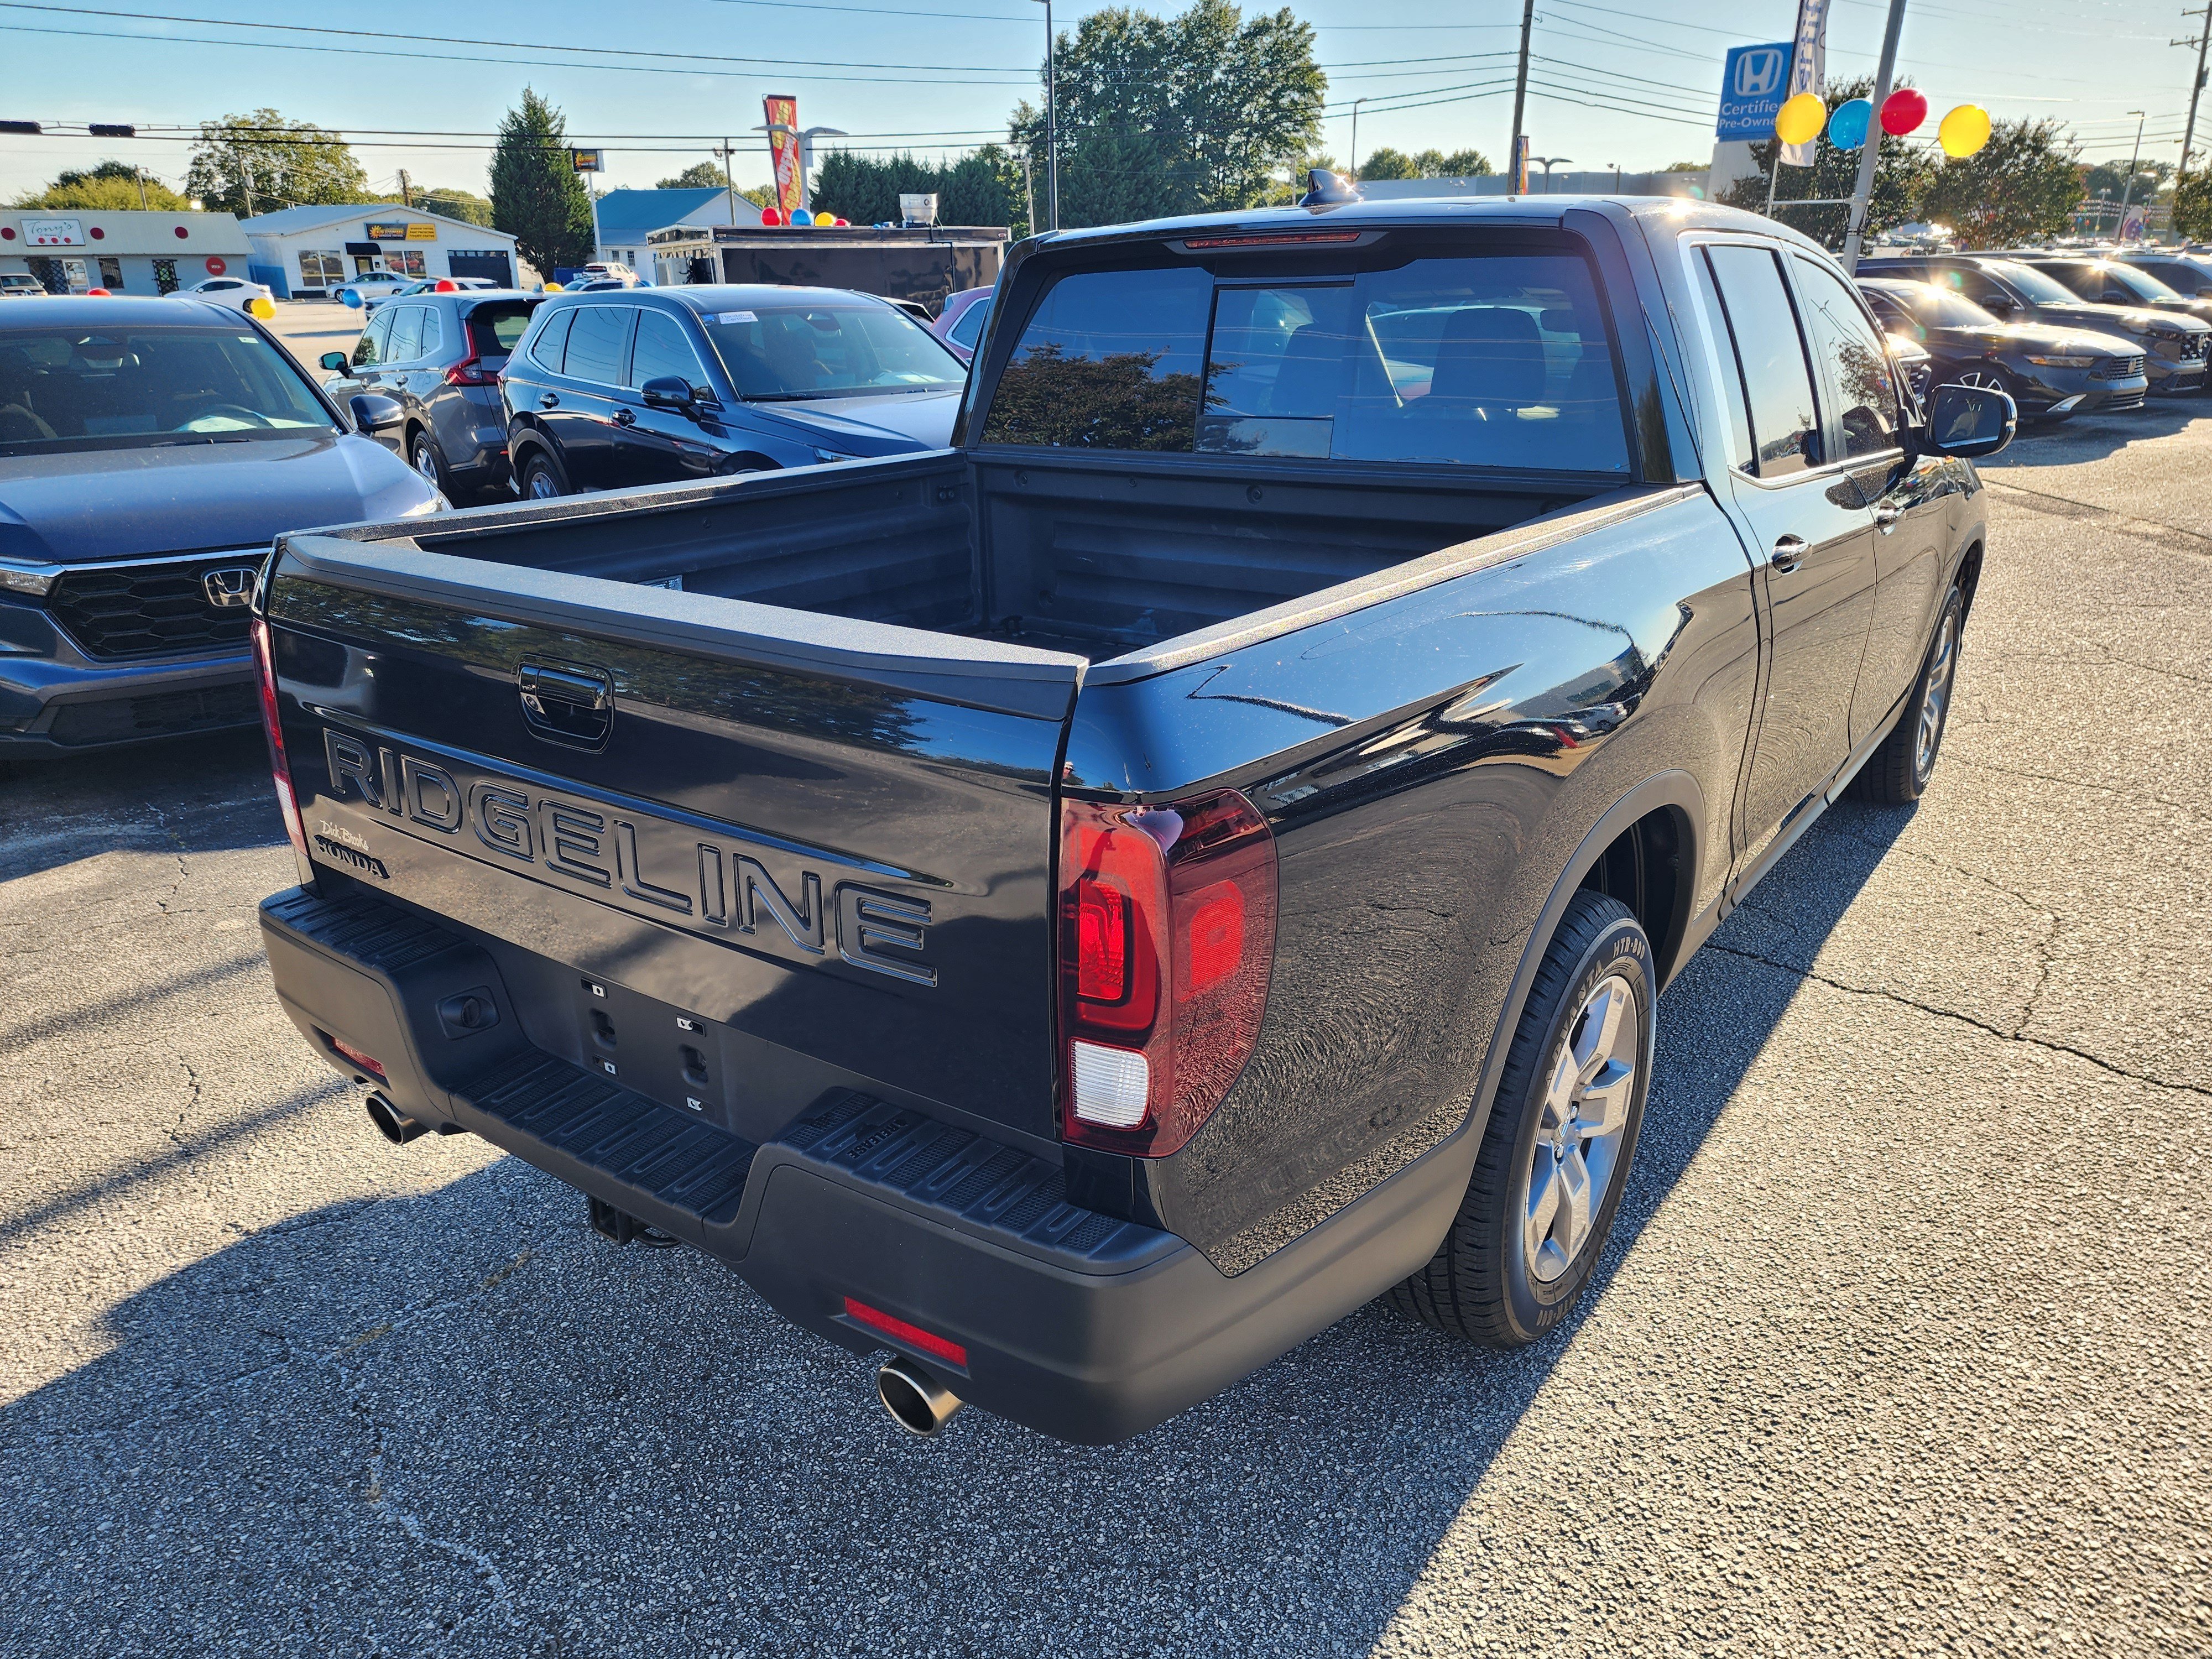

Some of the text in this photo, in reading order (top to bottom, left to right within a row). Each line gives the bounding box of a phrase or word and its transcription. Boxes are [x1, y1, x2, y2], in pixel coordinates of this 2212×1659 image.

[1718, 116, 1776, 129] Pre-Owne
[27, 221, 74, 238] Tony's
[320, 819, 369, 851] Dick Brooks
[314, 834, 390, 879] HONDA
[323, 727, 937, 988] RIDGELINE
[1613, 936, 1645, 960] HTR-800
[846, 1121, 901, 1160] RELEASE
